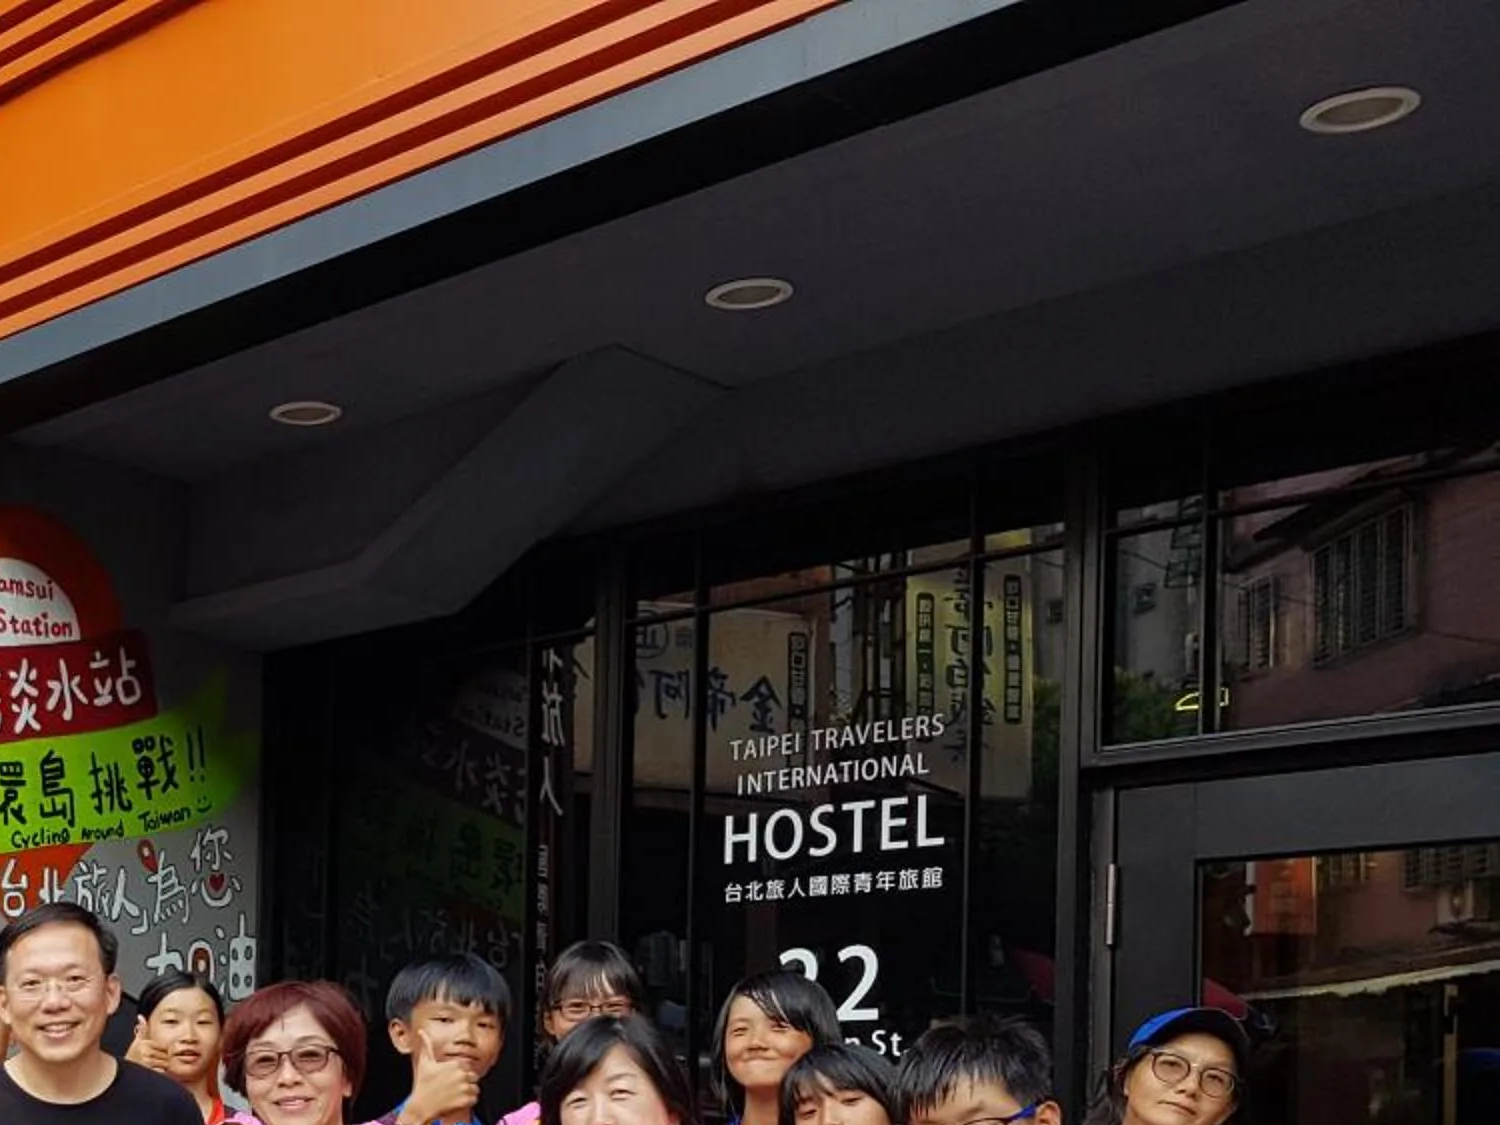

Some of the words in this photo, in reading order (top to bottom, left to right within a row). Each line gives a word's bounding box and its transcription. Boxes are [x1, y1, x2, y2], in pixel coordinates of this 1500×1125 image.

[730, 733, 800, 761] TAIPEI
[811, 713, 946, 750] TRAVELERS
[737, 752, 930, 796] INTERNATIONAL
[11, 827, 71, 850] Cycling
[138, 806, 192, 833] Taiwan
[723, 794, 946, 865] HOSTEL
[724, 866, 944, 904] 台北旅人國際青年旅館
